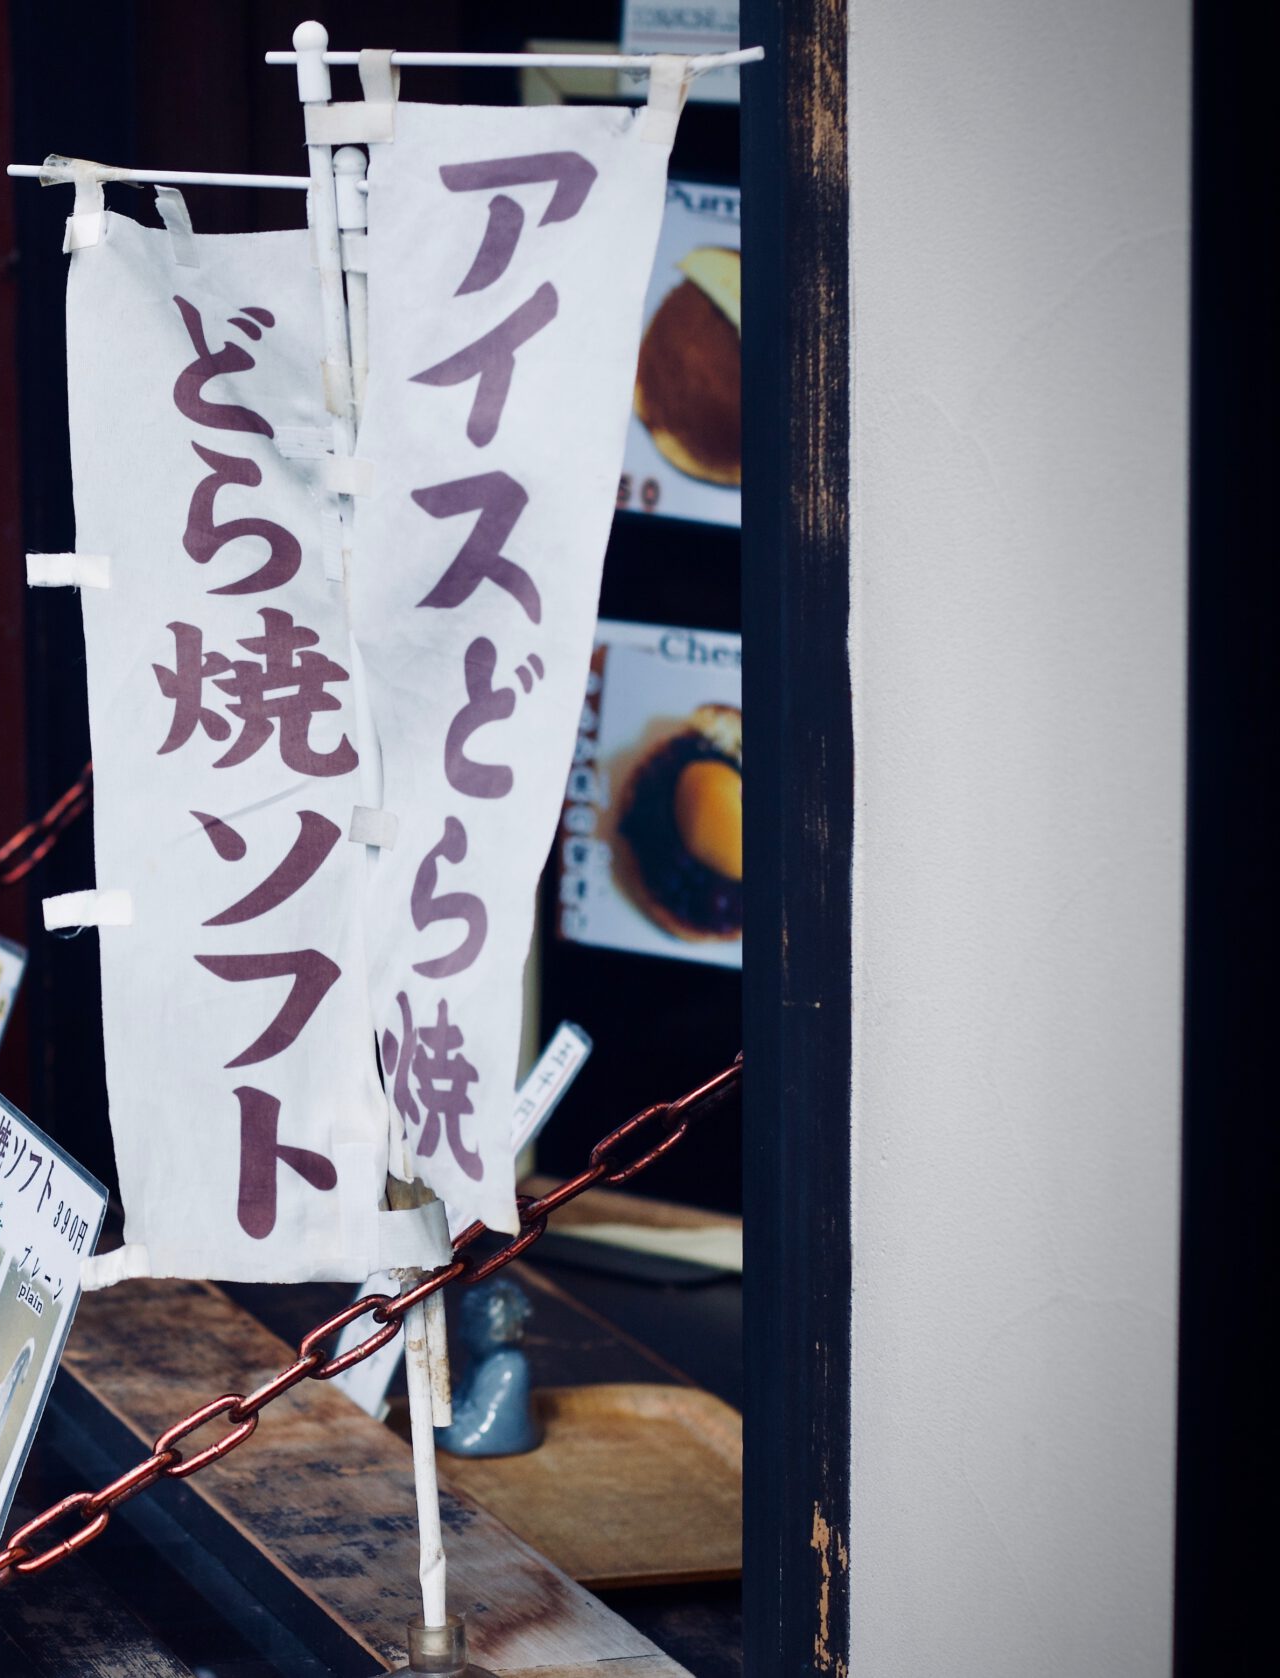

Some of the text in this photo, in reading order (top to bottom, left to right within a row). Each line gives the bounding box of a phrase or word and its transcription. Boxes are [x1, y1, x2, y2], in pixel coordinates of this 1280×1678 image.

[383, 151, 598, 1182] アイスどら焼
[152, 294, 360, 1240] どら焼ソフト
[53, 1200, 89, 1255] 390円
[18, 1283, 43, 1314] plain
[19, 1245, 64, 1300] プレーン
